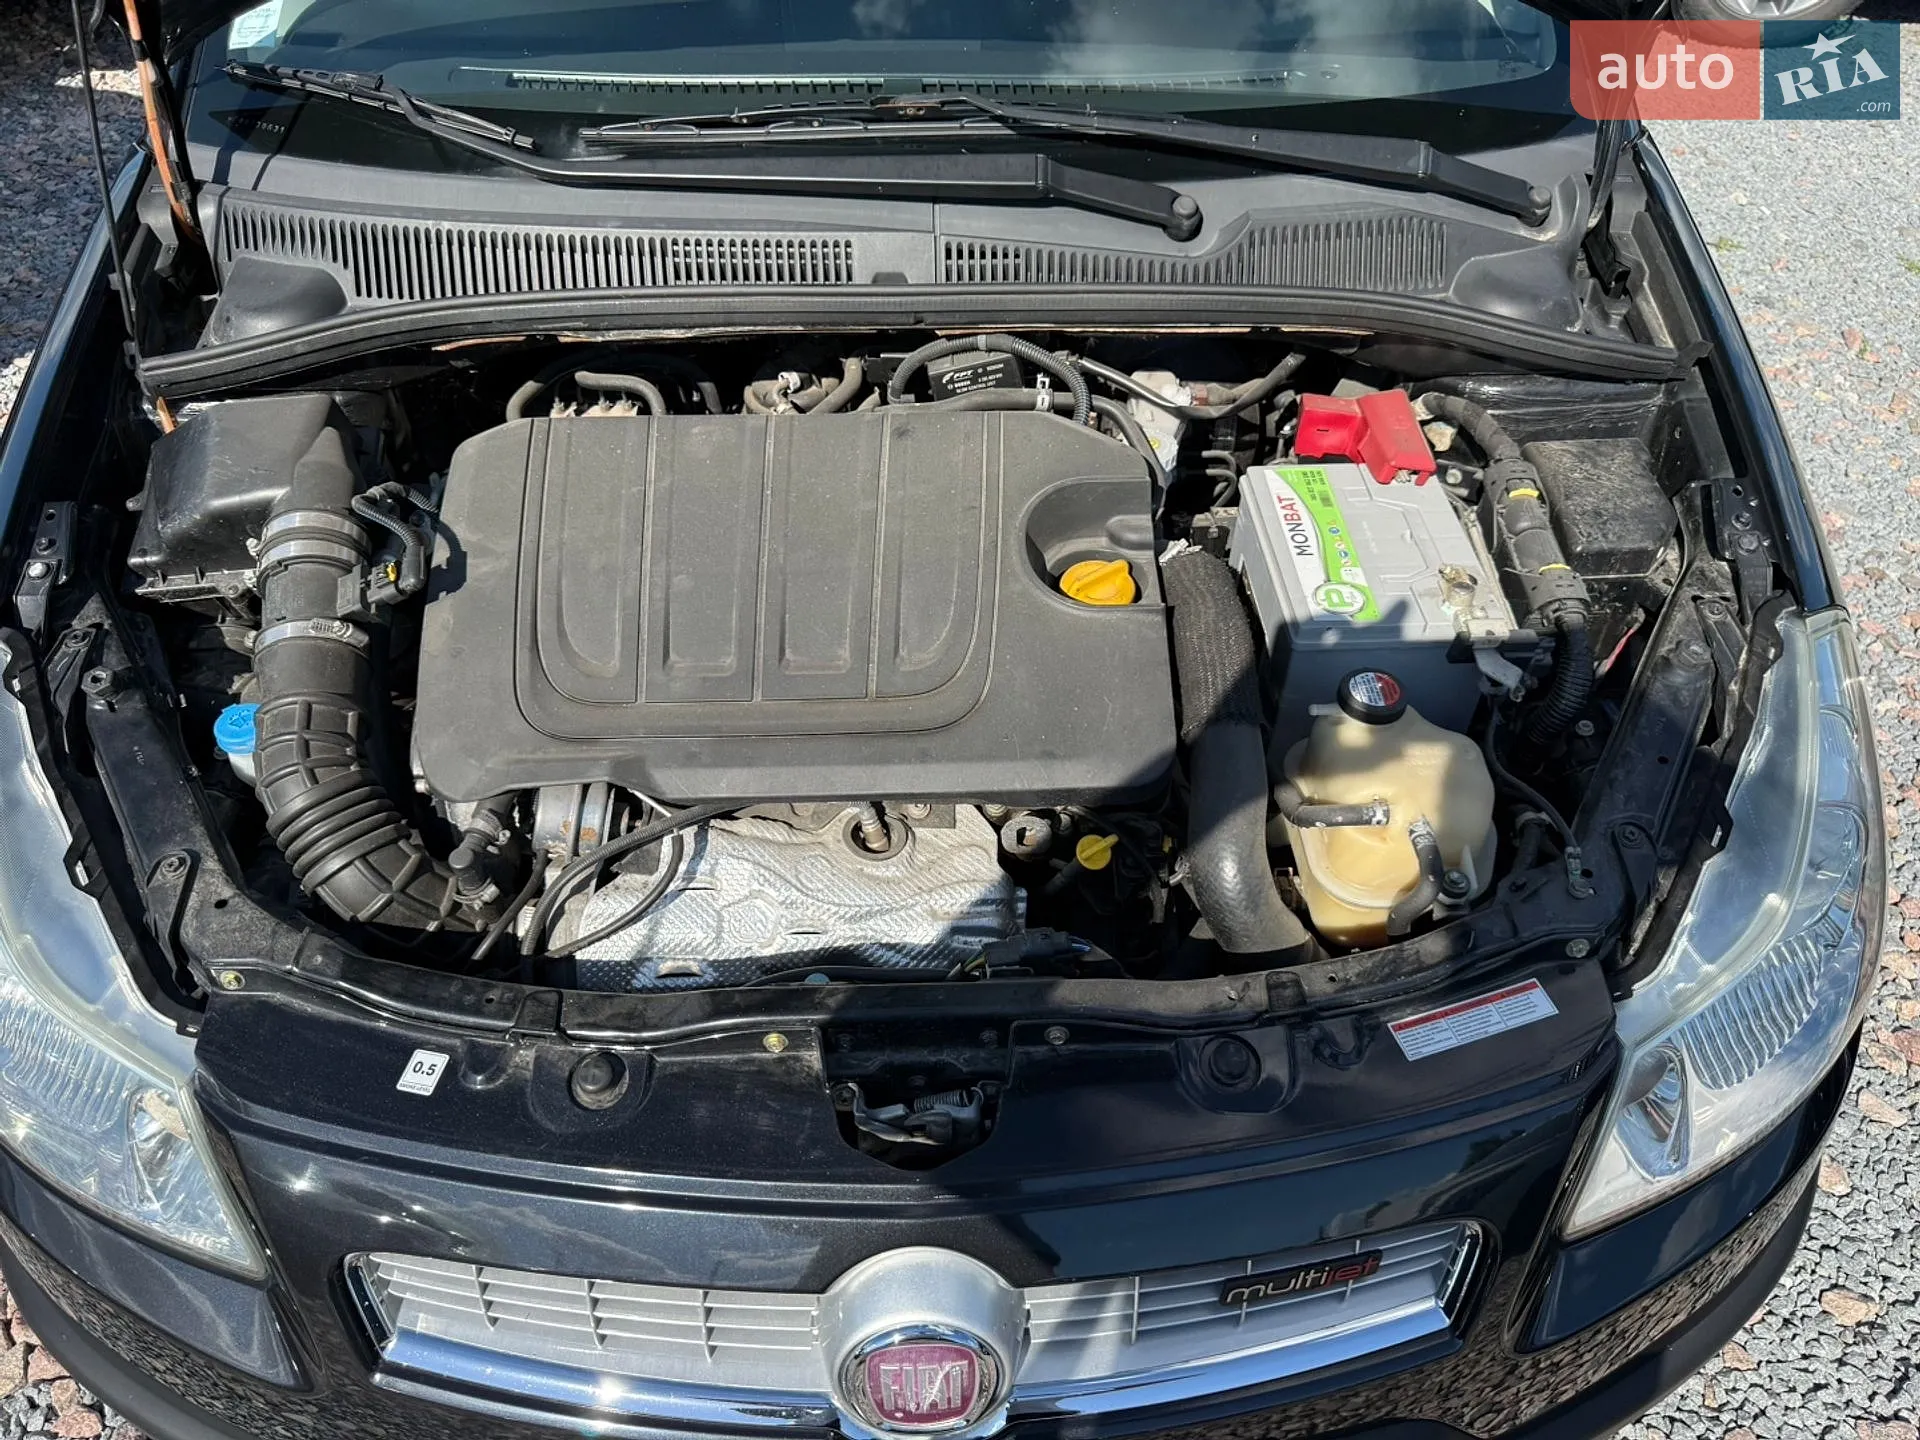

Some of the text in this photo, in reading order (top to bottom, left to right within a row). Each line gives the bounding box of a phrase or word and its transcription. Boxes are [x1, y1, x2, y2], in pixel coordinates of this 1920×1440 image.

[1277, 495, 1314, 556] MONBAT
[413, 1061, 437, 1076] 0.5
[1226, 1256, 1379, 1303] multijet
[879, 1360, 969, 1414] FIAT
